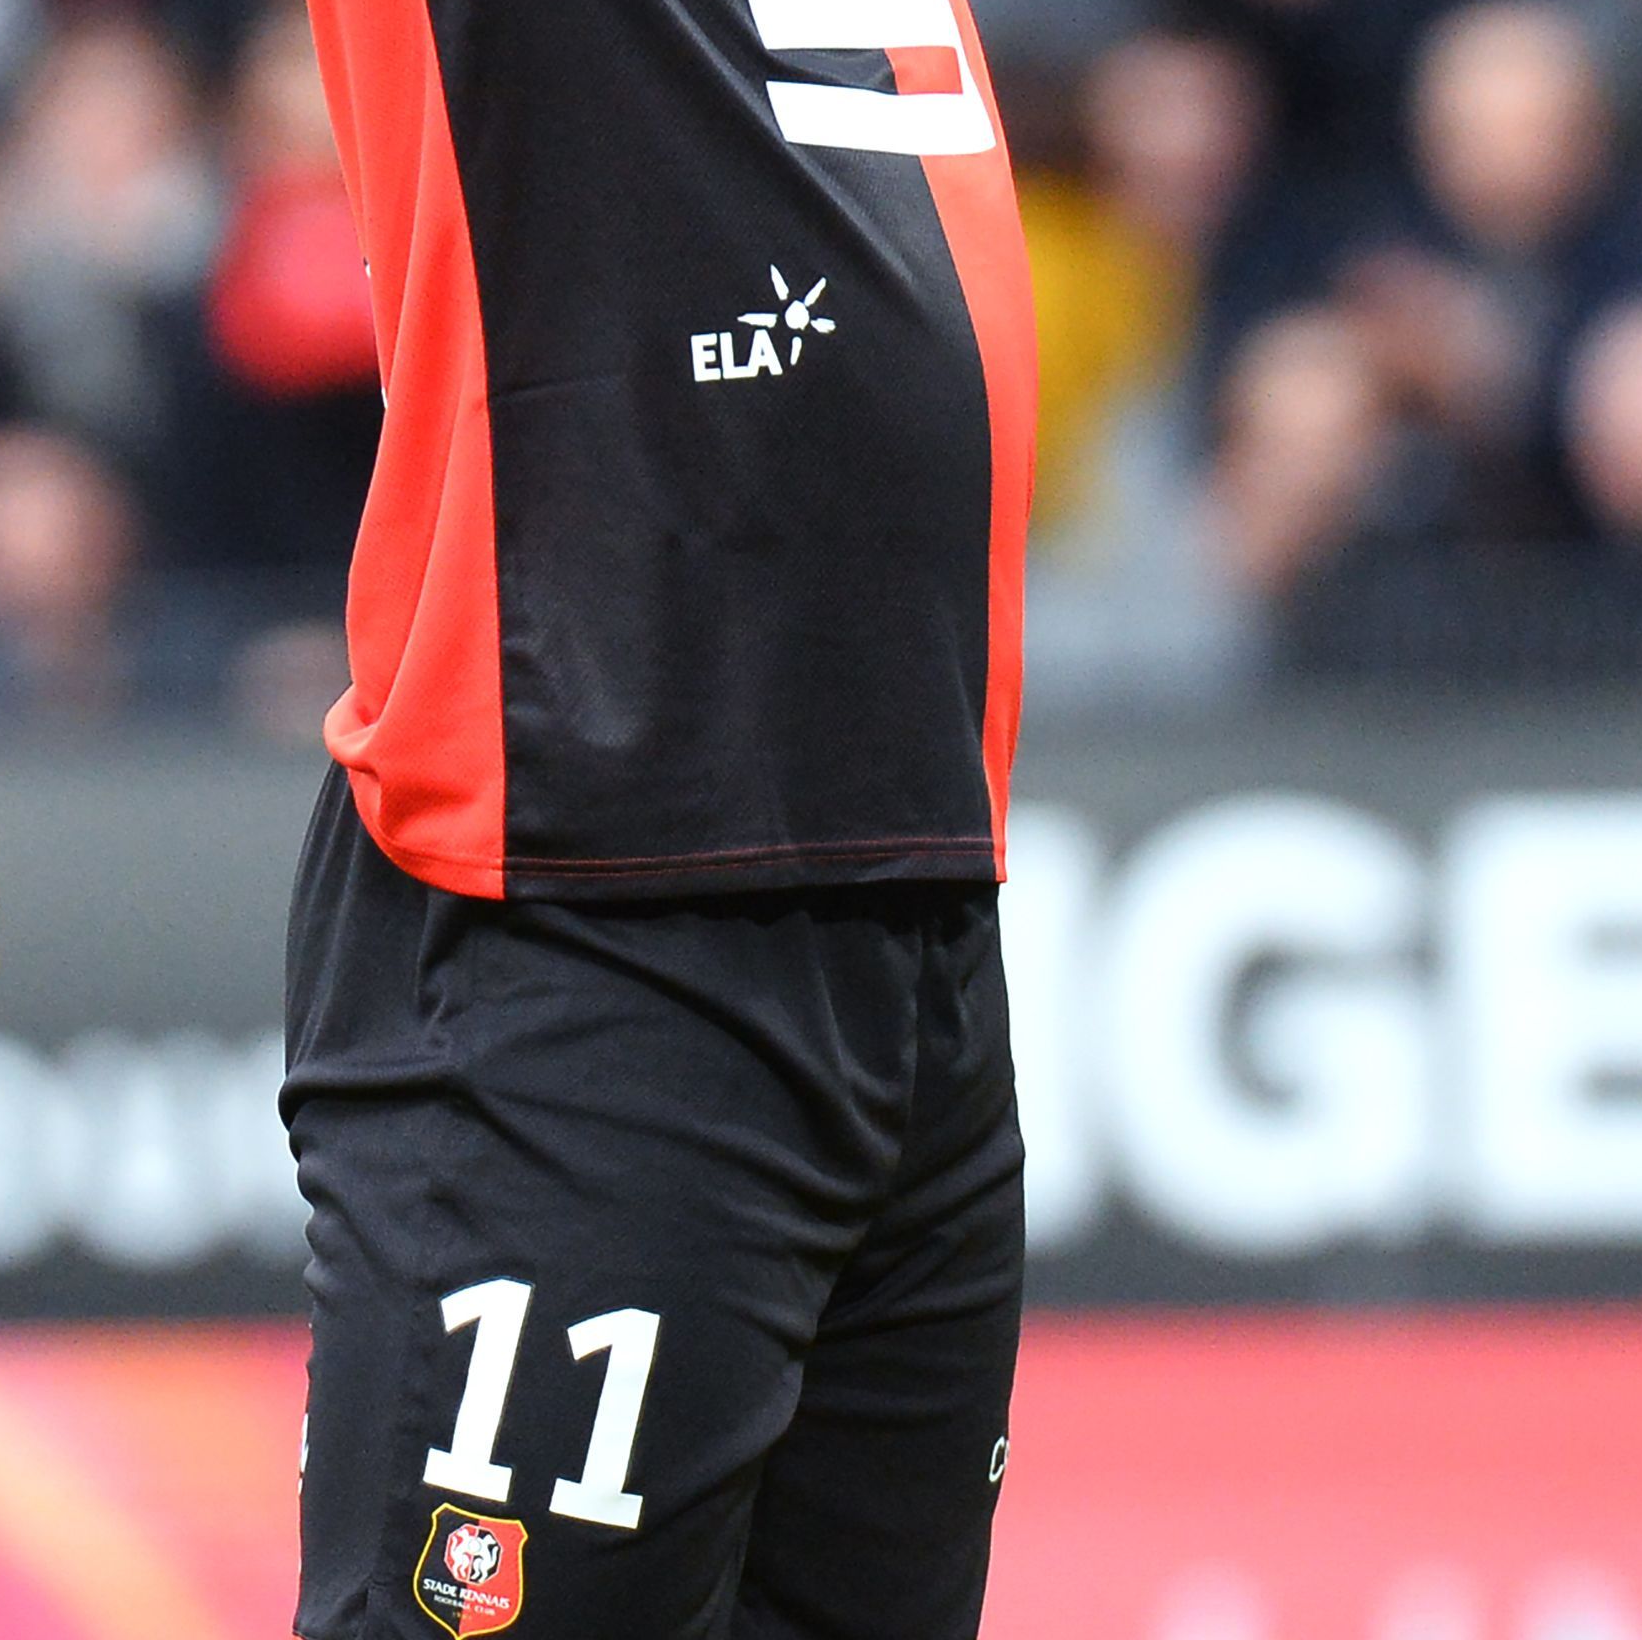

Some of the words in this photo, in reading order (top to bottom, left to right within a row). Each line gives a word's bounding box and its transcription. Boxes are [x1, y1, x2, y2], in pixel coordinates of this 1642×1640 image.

[690, 328, 783, 382] ELA
[422, 1276, 662, 1530] 11
[421, 1577, 458, 1597] STADE
[458, 1586, 511, 1610] RENNAIS
